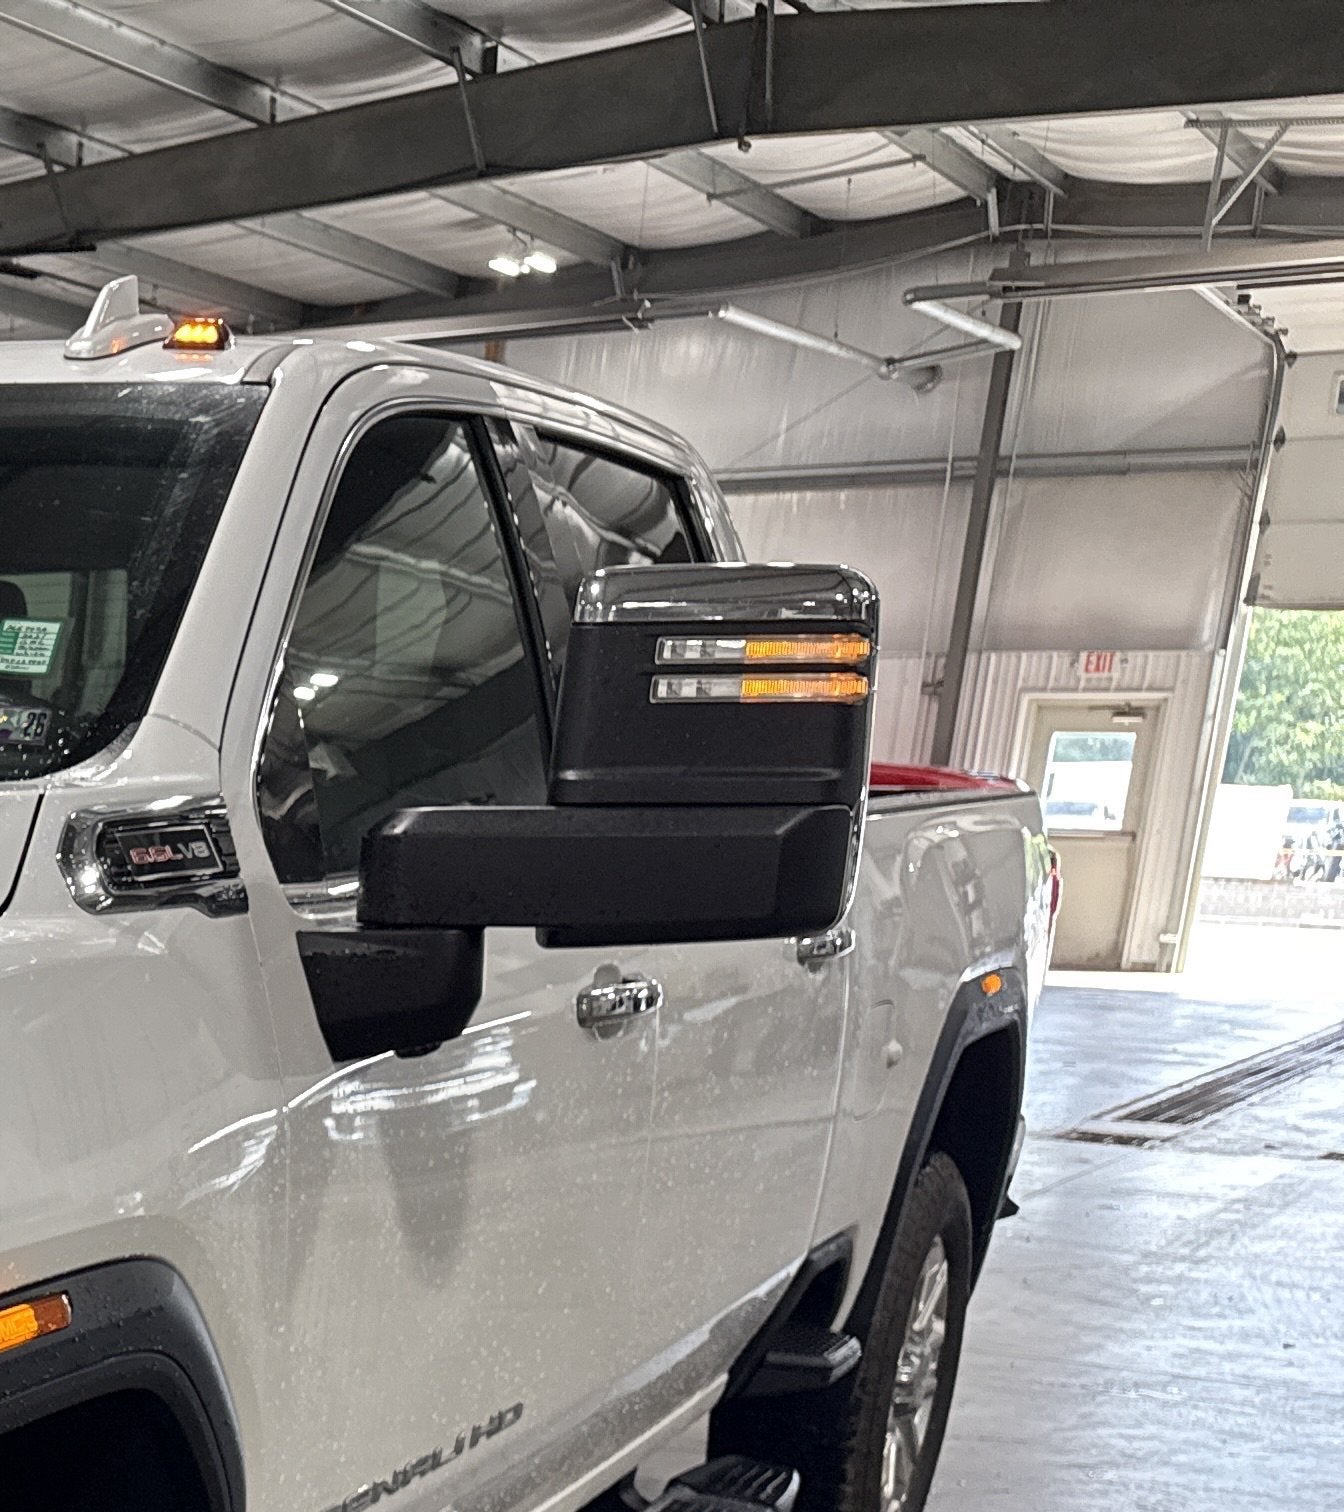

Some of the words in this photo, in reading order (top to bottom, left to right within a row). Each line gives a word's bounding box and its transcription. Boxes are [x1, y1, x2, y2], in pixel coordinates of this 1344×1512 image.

[1084, 651, 1116, 673] EXIT
[23, 711, 48, 737] 26
[176, 840, 211, 860] V8
[468, 1400, 524, 1450] HD
